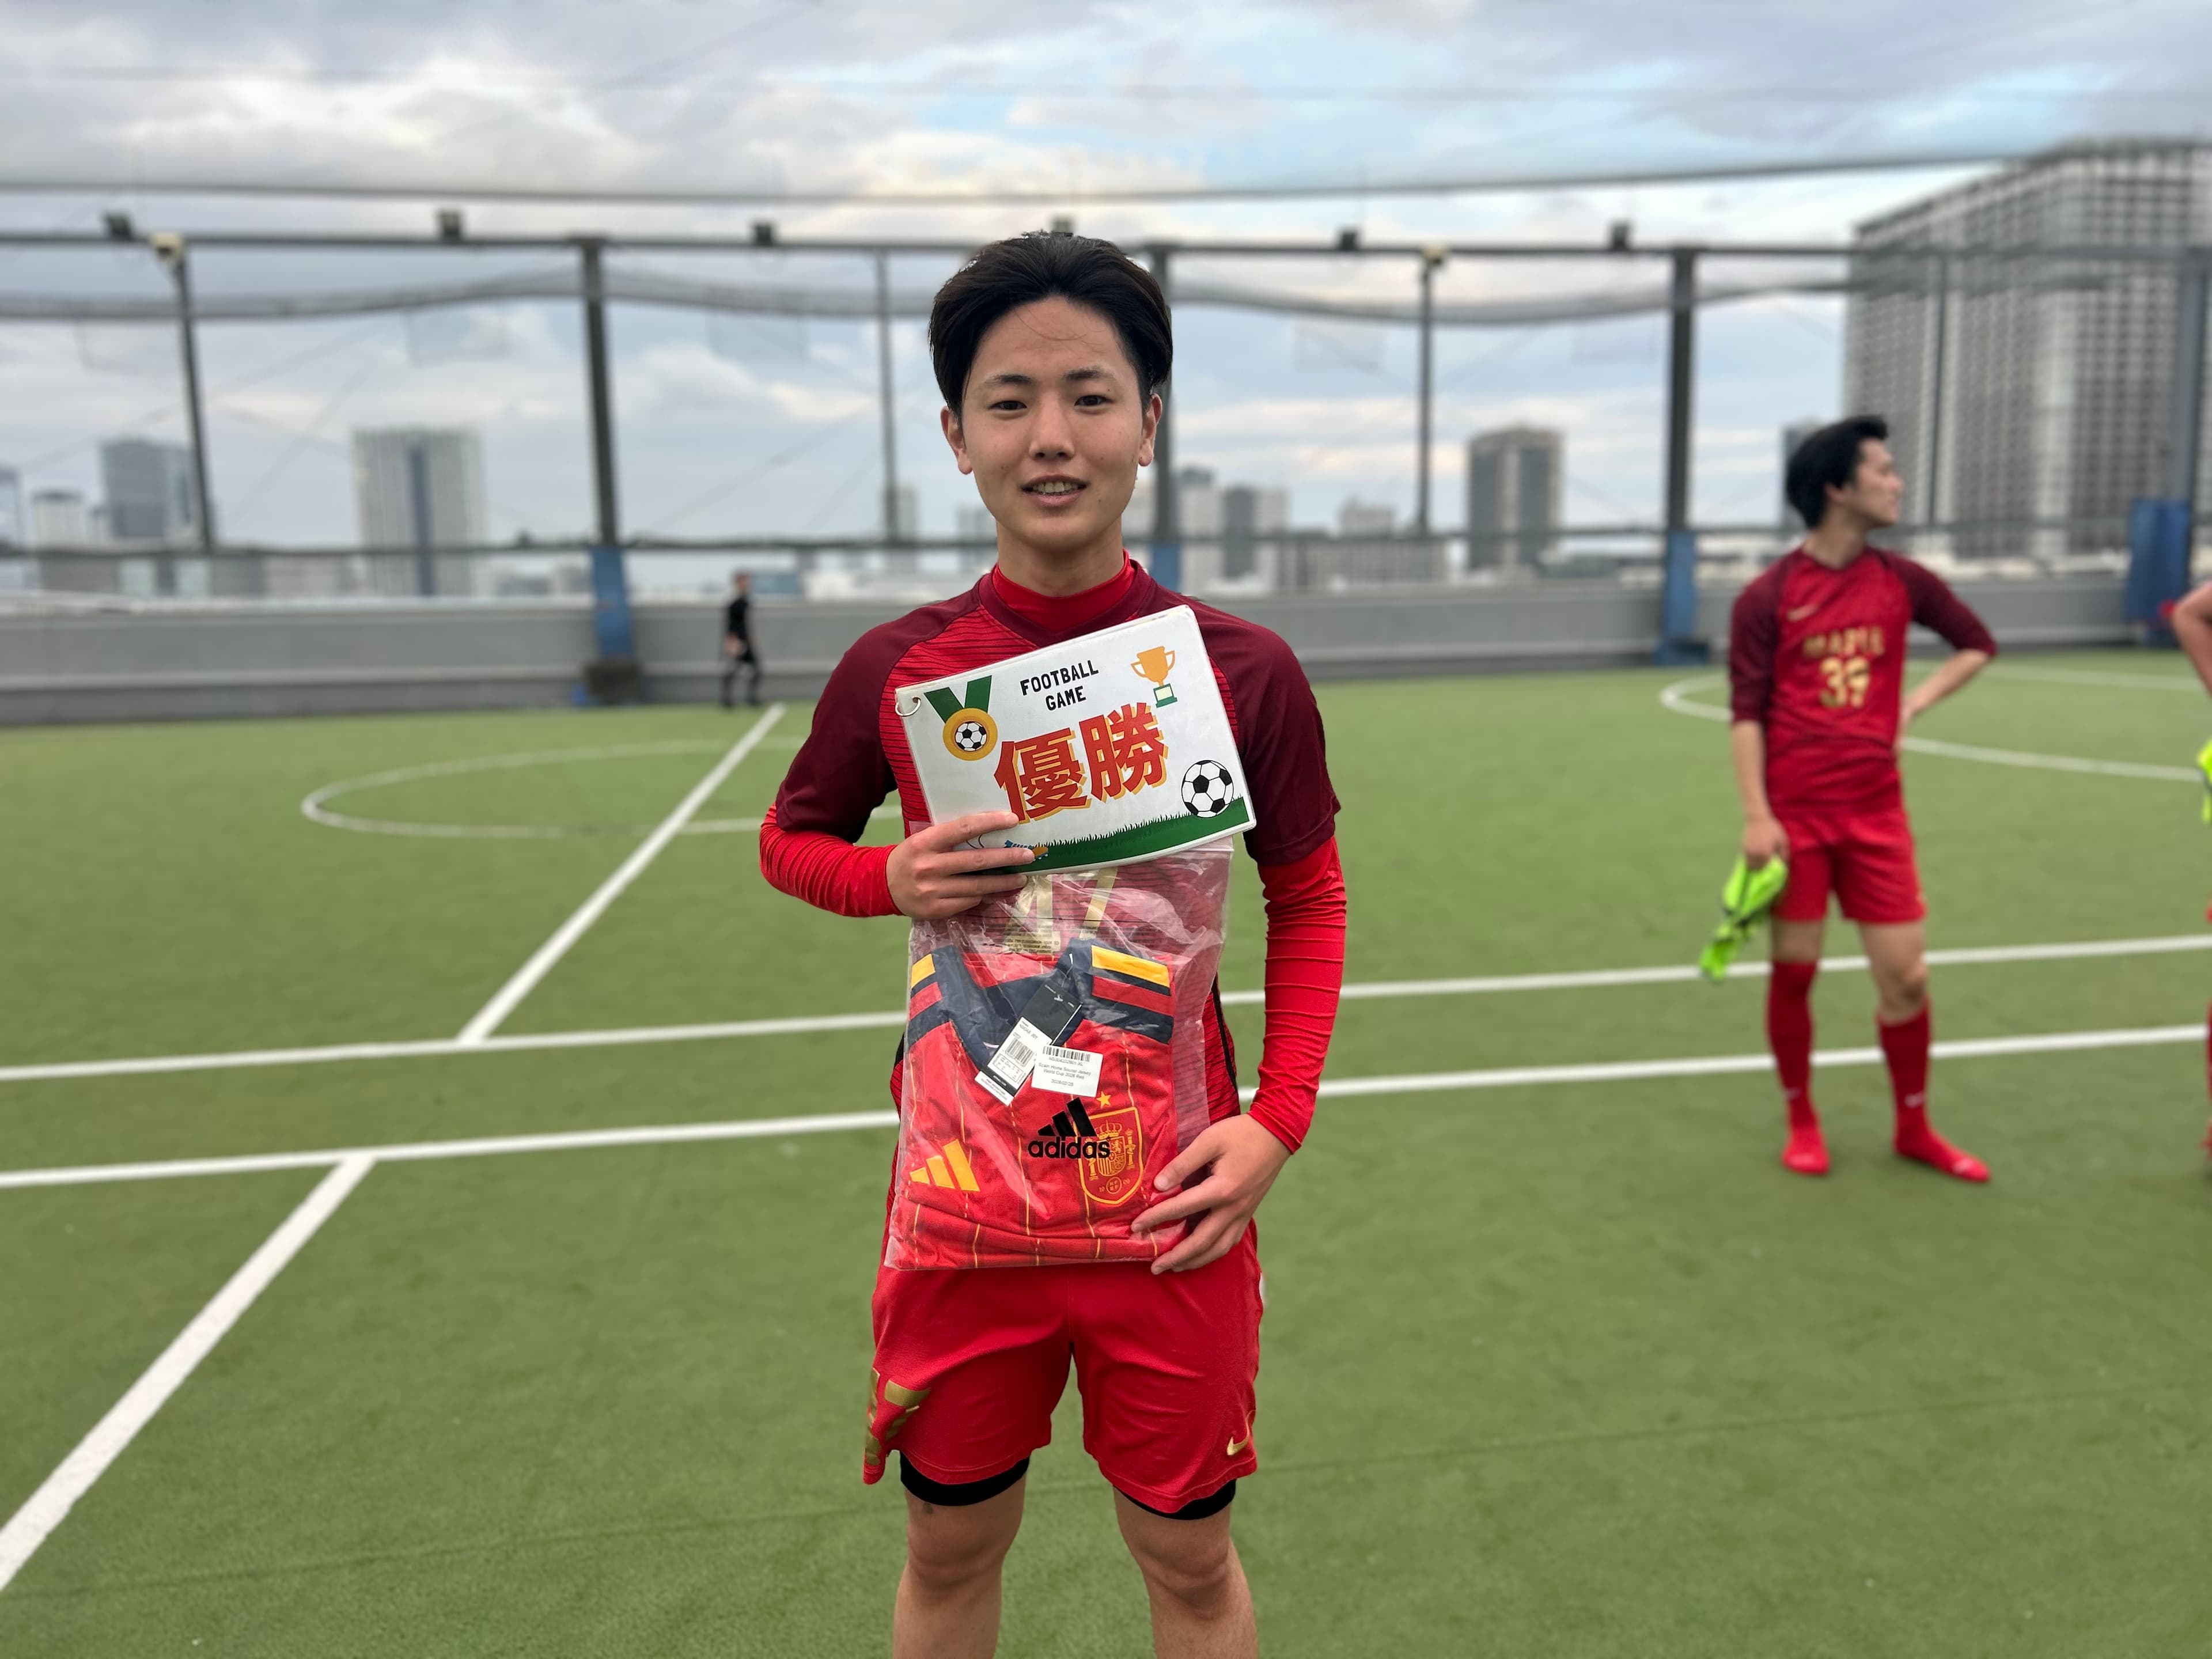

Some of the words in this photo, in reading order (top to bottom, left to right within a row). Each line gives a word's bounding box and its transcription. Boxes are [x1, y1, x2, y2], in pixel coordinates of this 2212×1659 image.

[1020, 660, 1099, 696] FOOTBALL
[1045, 685, 1086, 711] GAME
[994, 702, 1167, 824] 優勝
[1028, 1136, 1111, 1159] adidas
